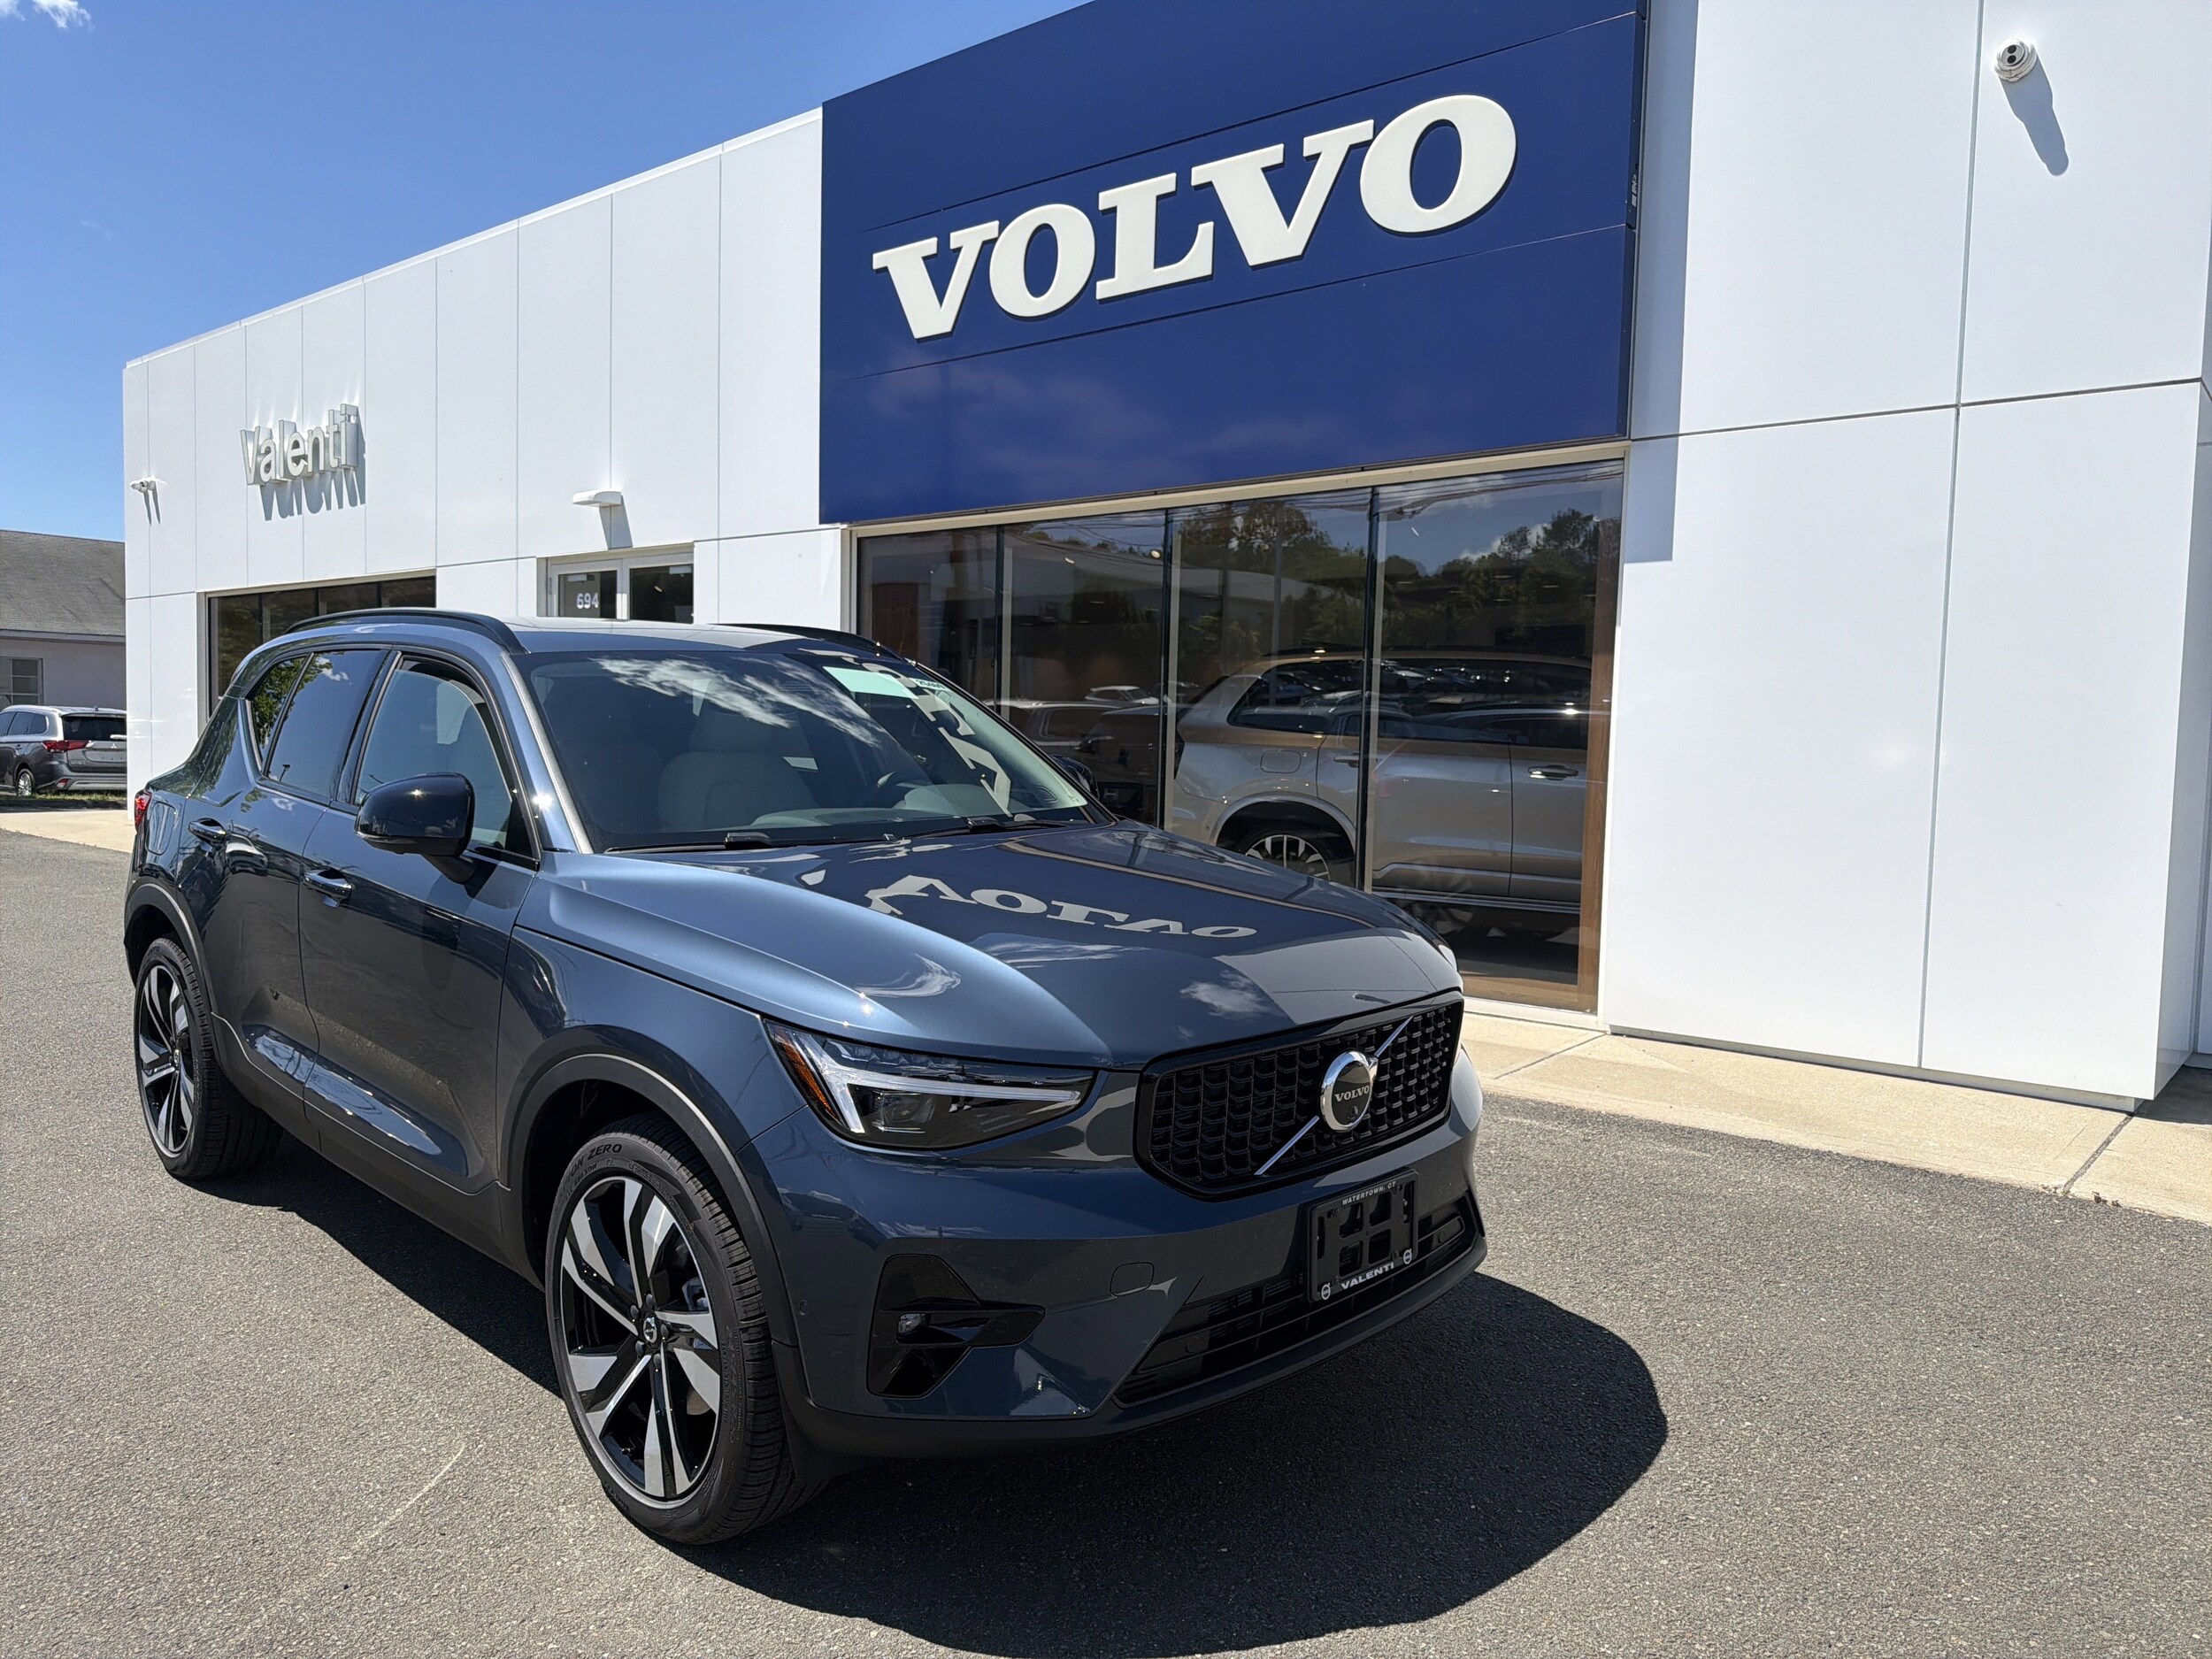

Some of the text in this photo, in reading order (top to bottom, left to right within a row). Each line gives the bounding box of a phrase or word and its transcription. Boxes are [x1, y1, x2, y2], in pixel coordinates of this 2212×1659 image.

[872, 94, 1517, 340] VOLVO
[240, 403, 355, 486] Valenti
[576, 592, 599, 609] 694
[1334, 1085, 1370, 1102] VOLVO
[587, 1144, 622, 1160] ZERO
[1340, 1262, 1394, 1289] VALENTI
